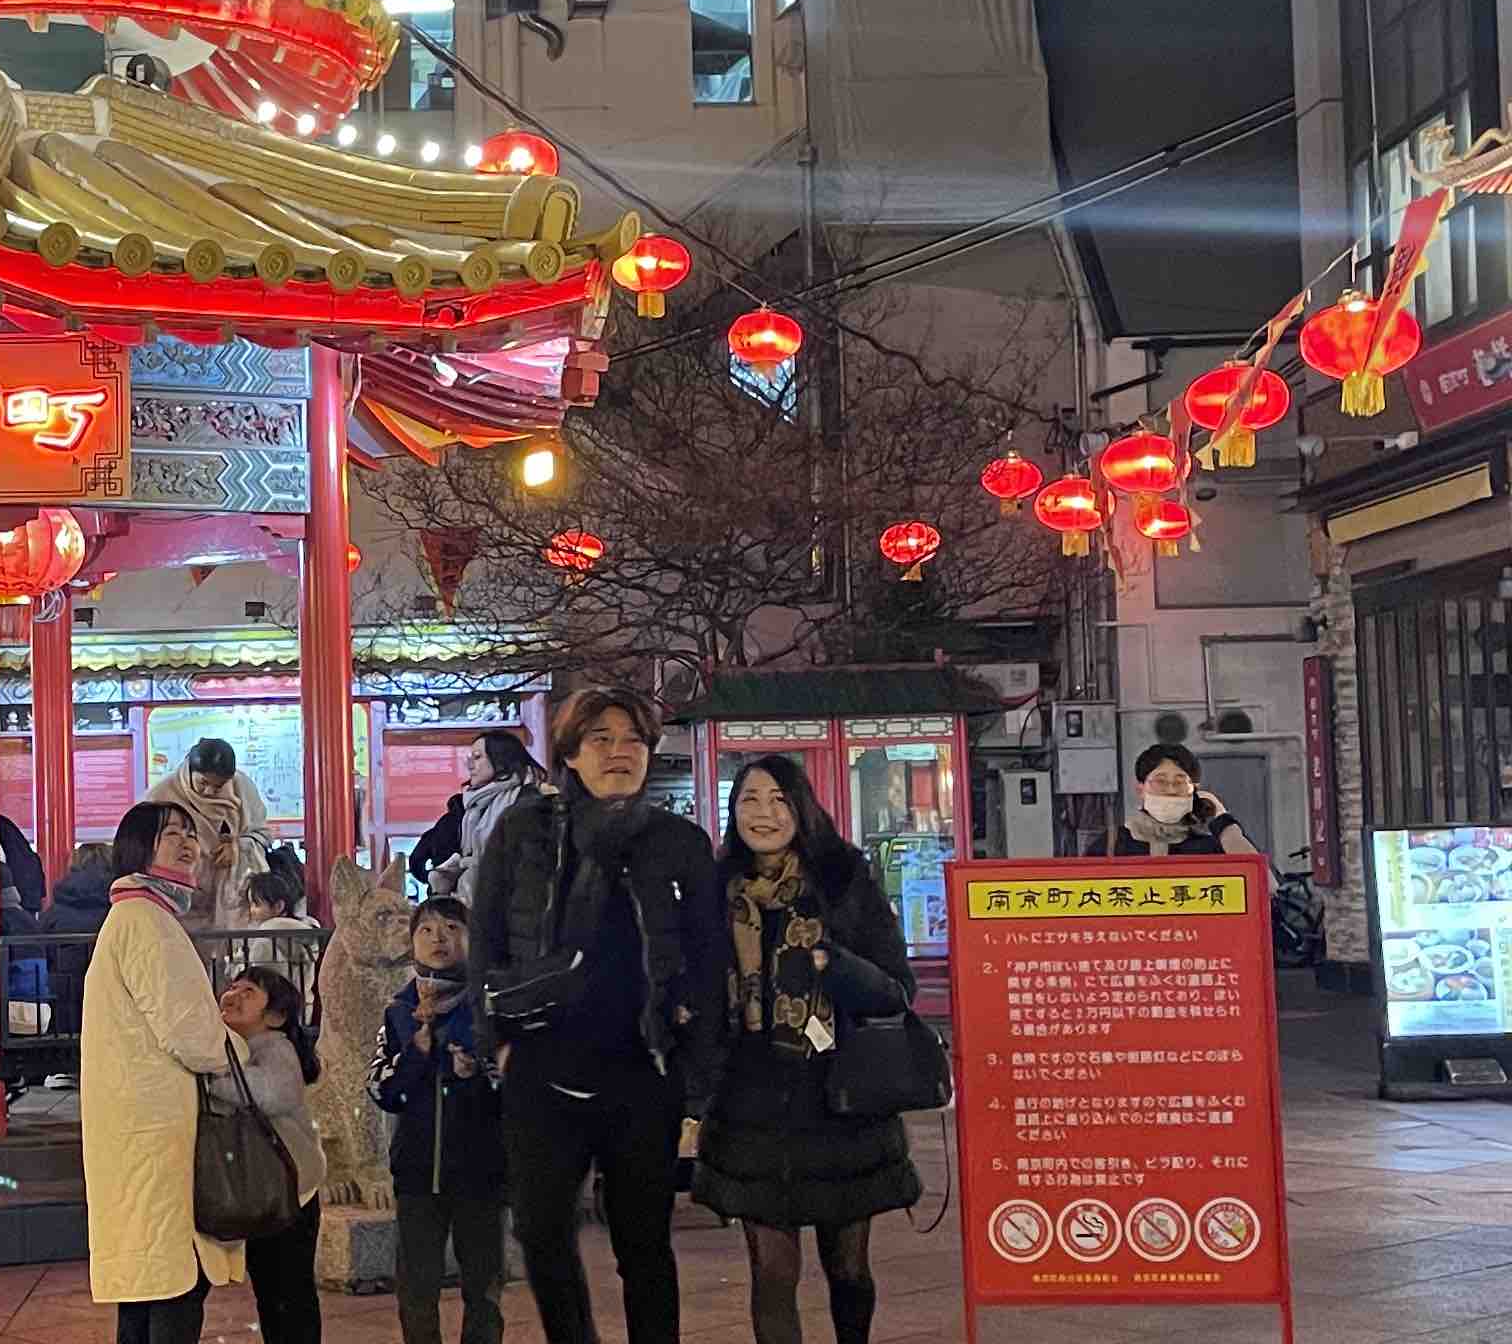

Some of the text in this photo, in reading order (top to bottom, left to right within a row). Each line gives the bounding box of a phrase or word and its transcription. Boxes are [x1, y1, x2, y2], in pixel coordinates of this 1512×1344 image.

[986, 884, 1226, 912] 南京町内禁止事項
